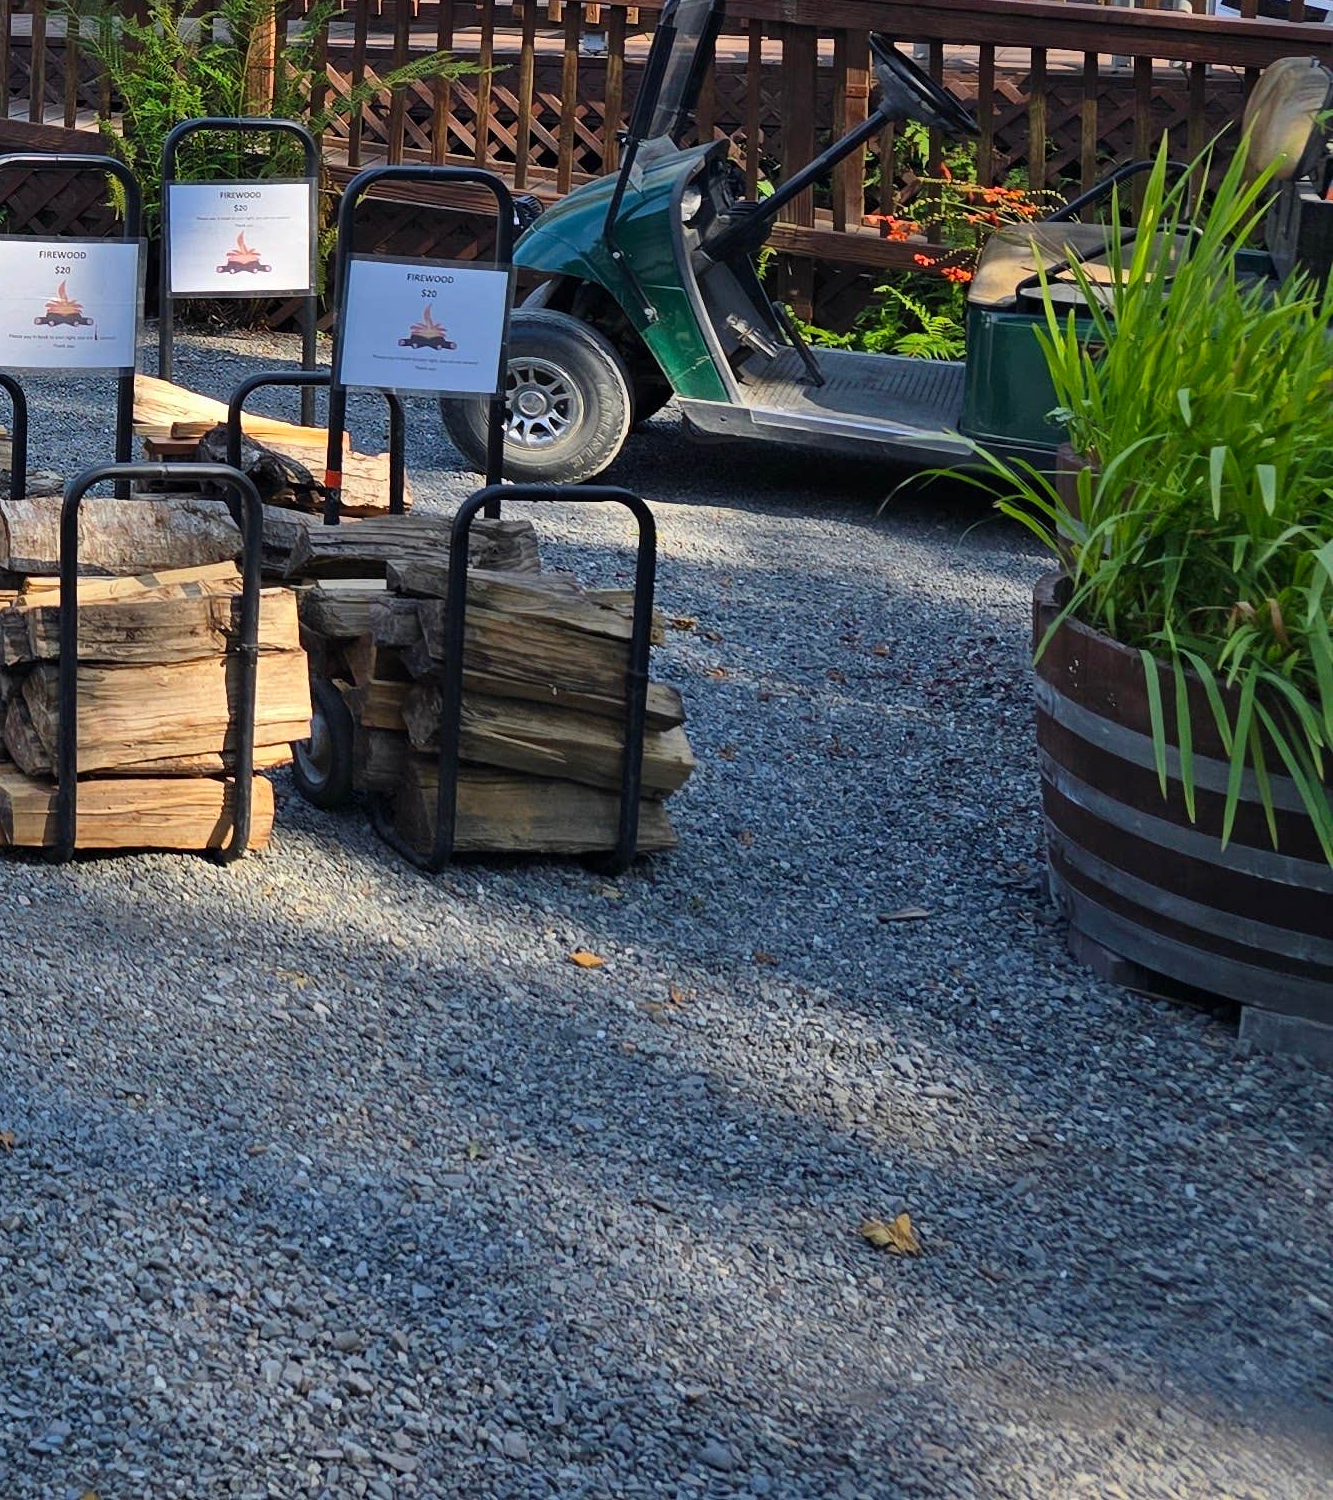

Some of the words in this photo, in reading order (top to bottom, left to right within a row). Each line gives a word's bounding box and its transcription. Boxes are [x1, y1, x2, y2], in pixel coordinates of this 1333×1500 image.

[220, 191, 261, 199] FIREWOOD
[233, 204, 248, 212] $20
[39, 250, 87, 260] FIREWOOD
[54, 266, 71, 275] $20
[406, 273, 455, 284] FIREWOOD
[421, 289, 438, 298] $20
